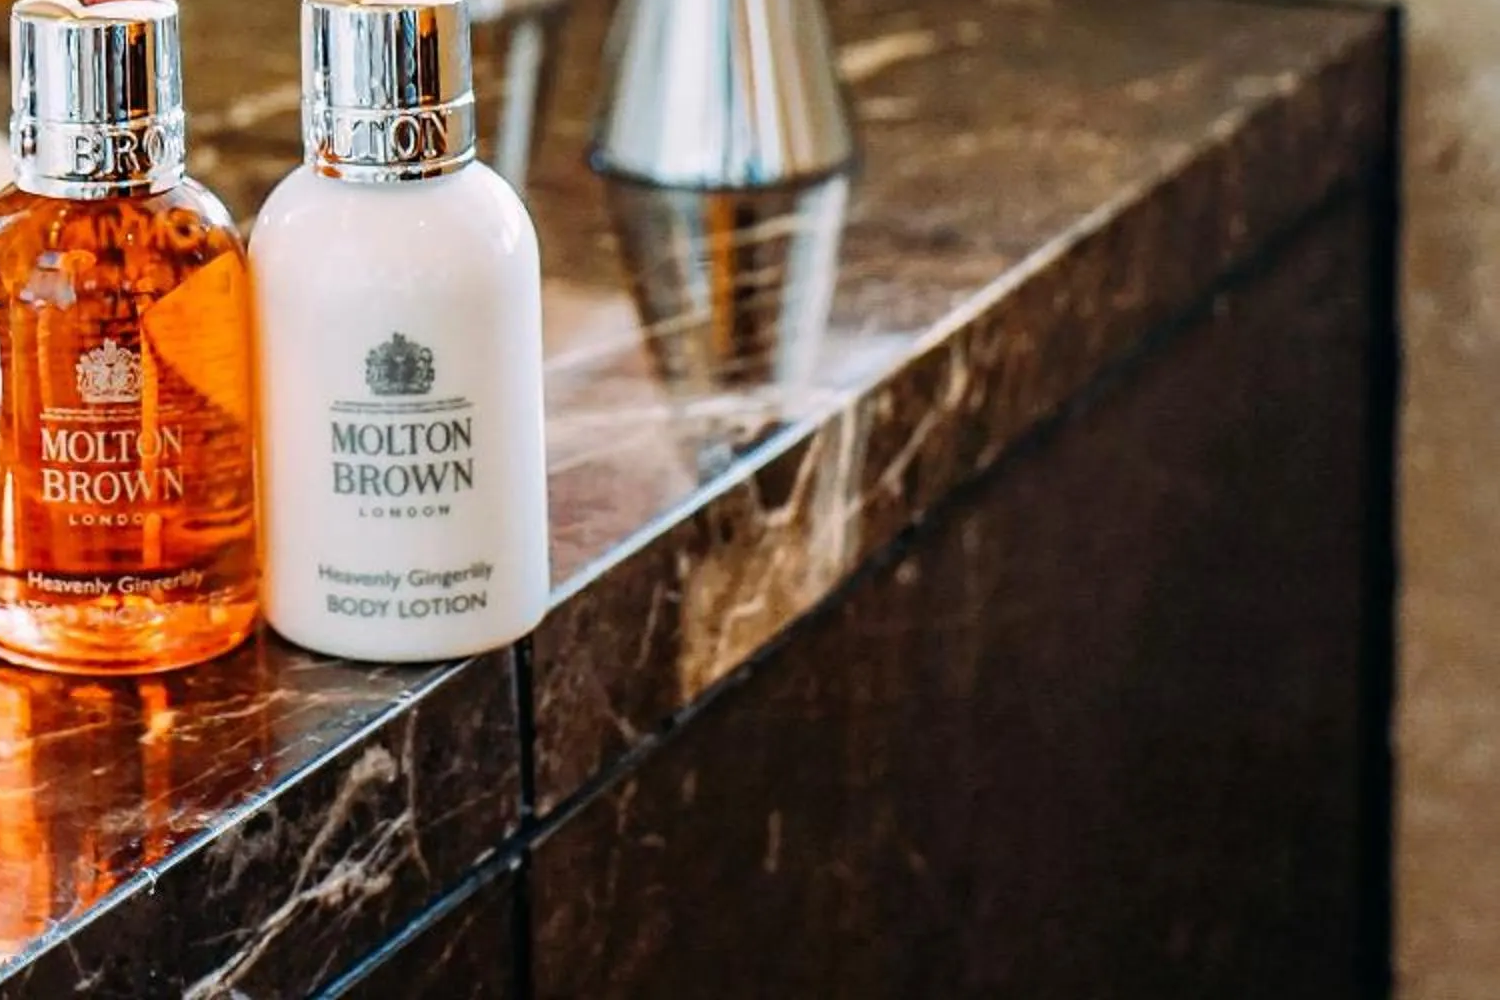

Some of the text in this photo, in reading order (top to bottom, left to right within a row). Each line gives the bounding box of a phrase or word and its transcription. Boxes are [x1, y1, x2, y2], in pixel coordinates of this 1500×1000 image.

[72, 128, 176, 175] BRO
[41, 424, 183, 463] MOLTON
[331, 417, 473, 456] MOLTON
[41, 467, 184, 505] BROWN
[333, 458, 474, 497] BROWN
[68, 513, 145, 526] LONDO
[359, 505, 450, 518] LONDON
[27, 570, 112, 595] Heavenly
[318, 565, 401, 591] Heavenly
[327, 591, 487, 618] BODY LOTION
